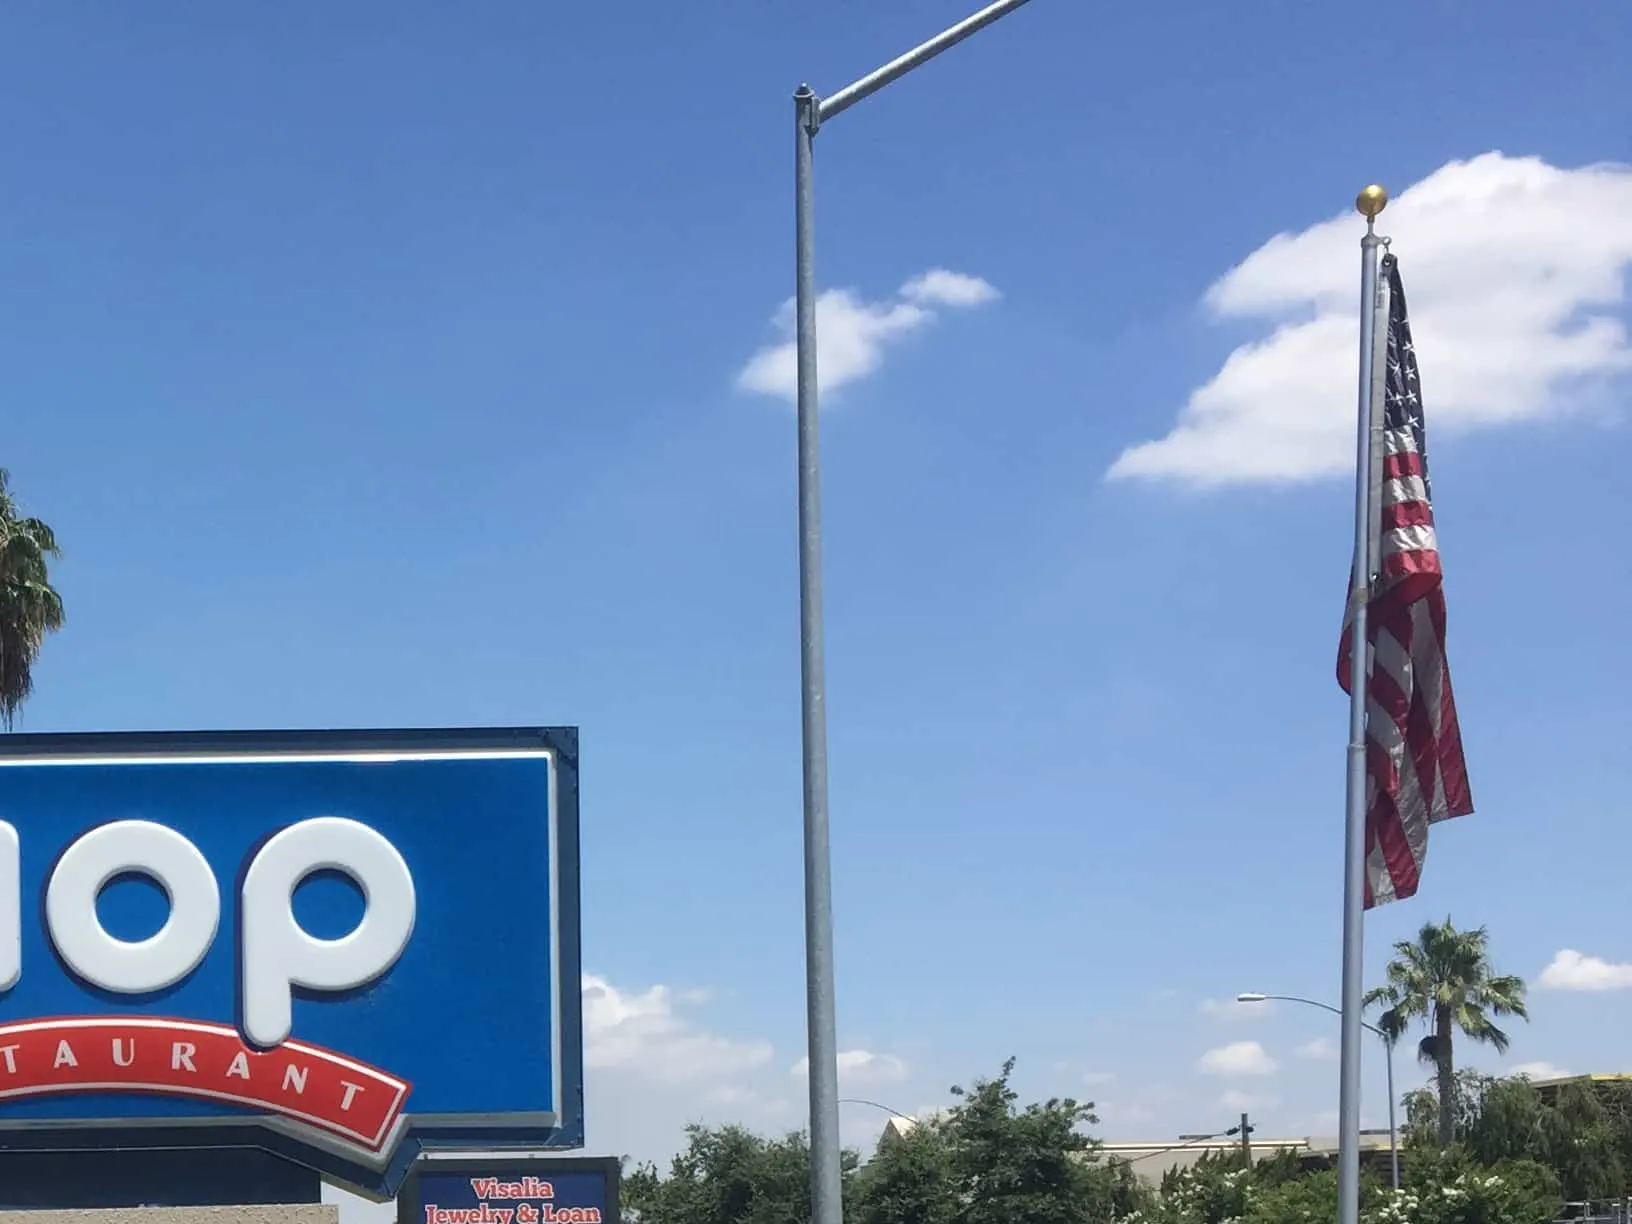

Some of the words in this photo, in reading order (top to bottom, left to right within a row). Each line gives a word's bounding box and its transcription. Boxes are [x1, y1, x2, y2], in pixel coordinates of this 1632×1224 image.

[471, 1177, 554, 1199] Visalia
[517, 1204, 539, 1224] &
[542, 1203, 602, 1224] Loan
